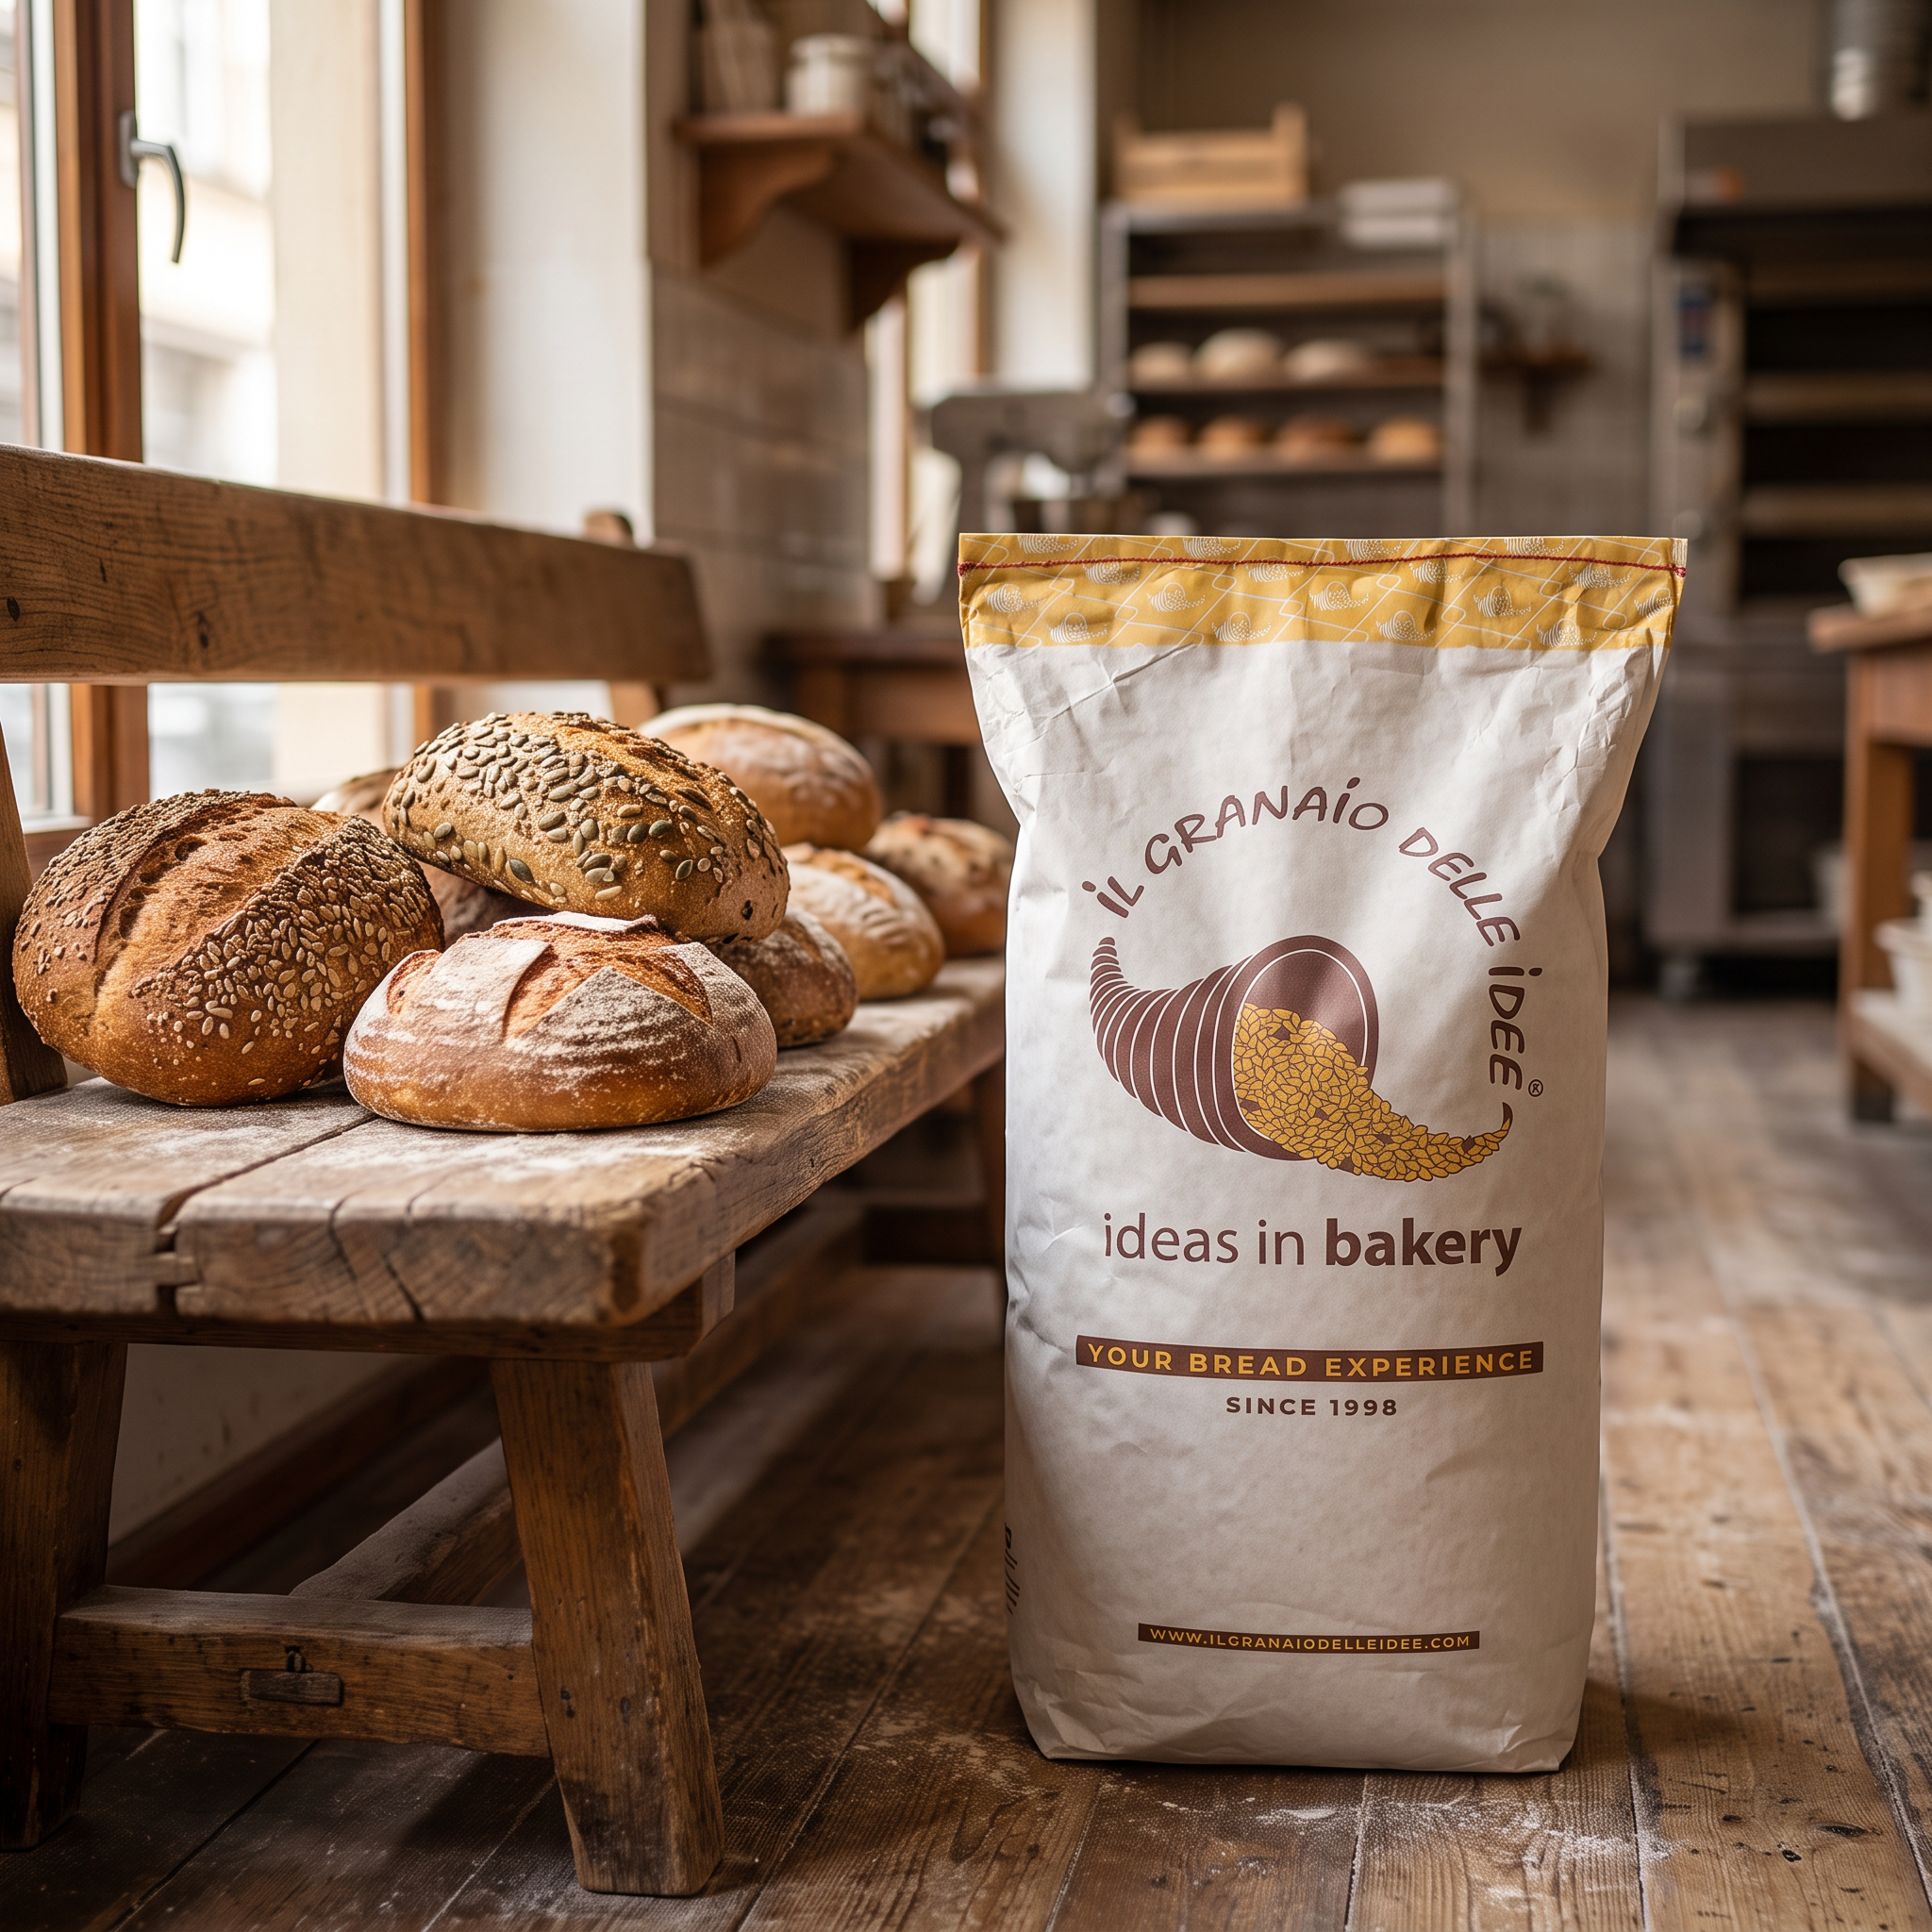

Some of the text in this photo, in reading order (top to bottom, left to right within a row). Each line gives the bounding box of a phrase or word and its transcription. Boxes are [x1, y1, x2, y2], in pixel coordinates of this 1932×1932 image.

[1398, 826, 1521, 947] DELLE
[1103, 1212, 1523, 1277] ideas in bakery
[1088, 1343, 1533, 1377] YOUR BREAD EXPERIENCE
[1225, 1396, 1398, 1417] SINCE 1998
[1149, 1627, 1470, 1651] WWW.ILGRANAIODELLEIDEE.COM
